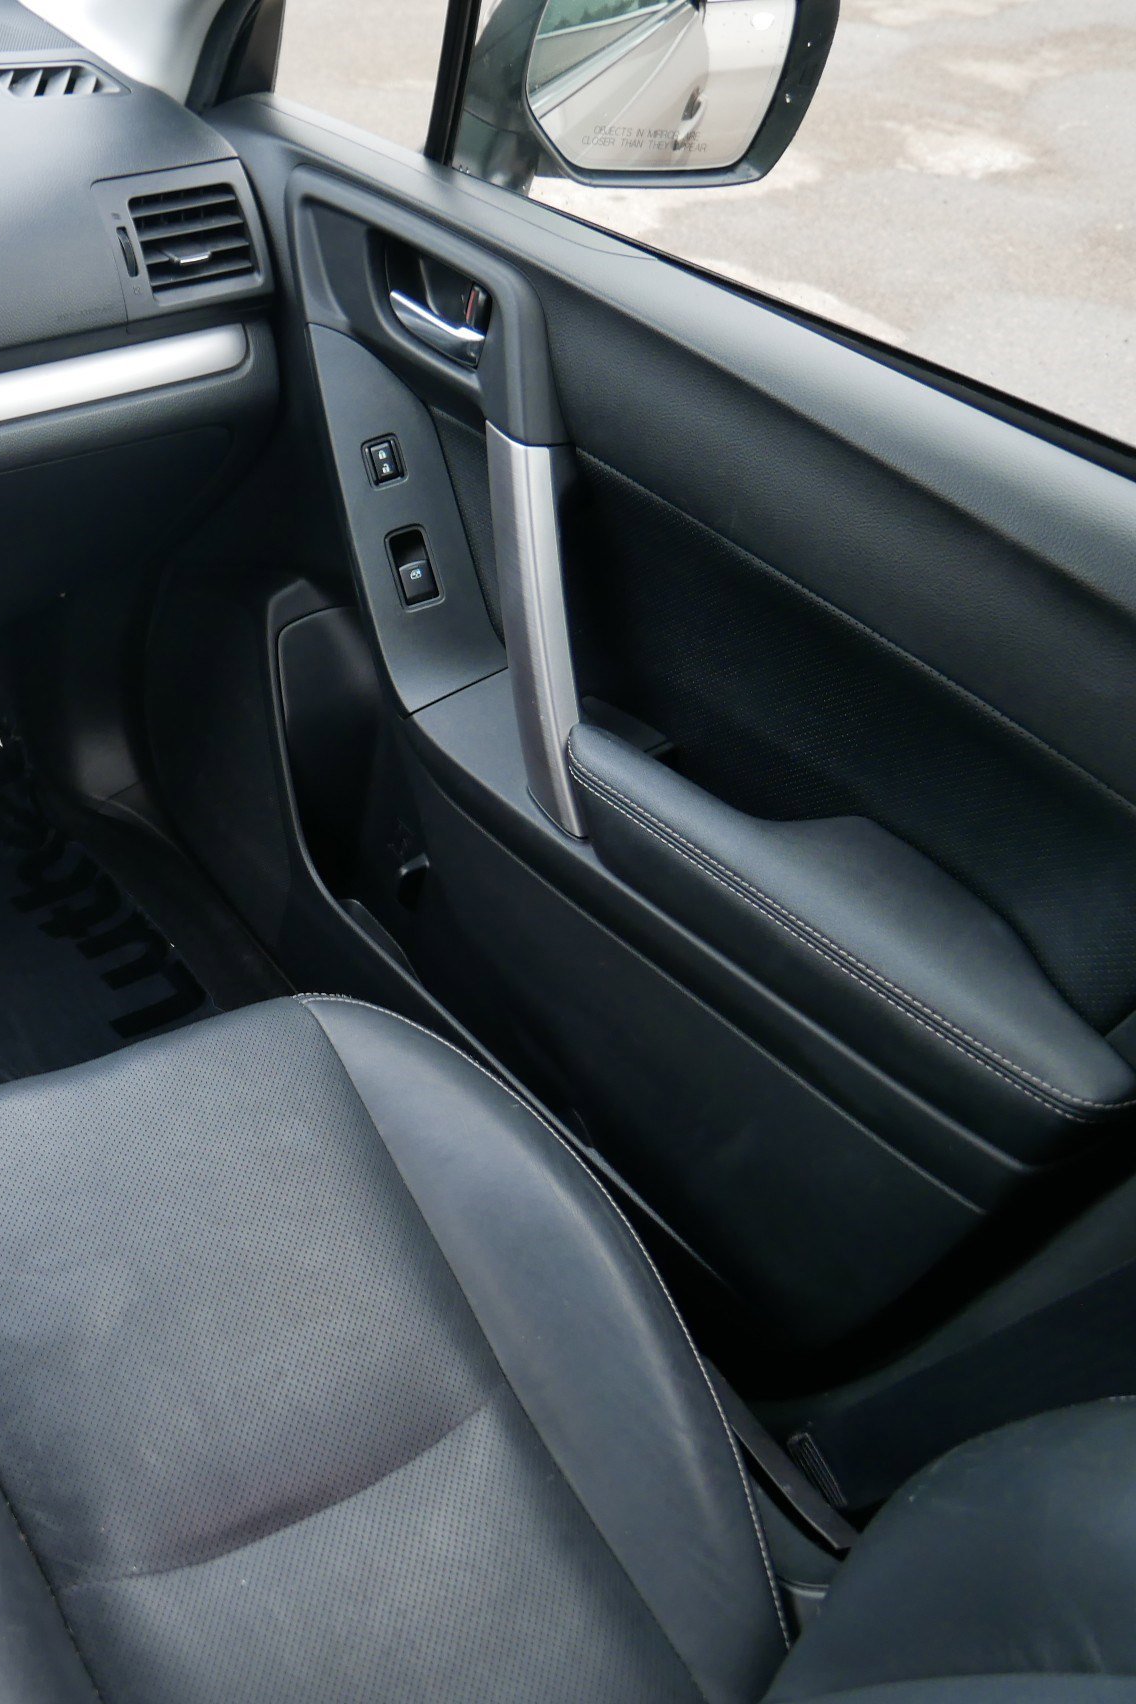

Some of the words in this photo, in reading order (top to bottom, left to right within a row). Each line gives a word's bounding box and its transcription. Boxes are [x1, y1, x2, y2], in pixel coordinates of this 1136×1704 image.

[581, 135, 616, 147] CLOSER
[621, 138, 644, 149] THAN
[649, 140, 670, 151] THEY
